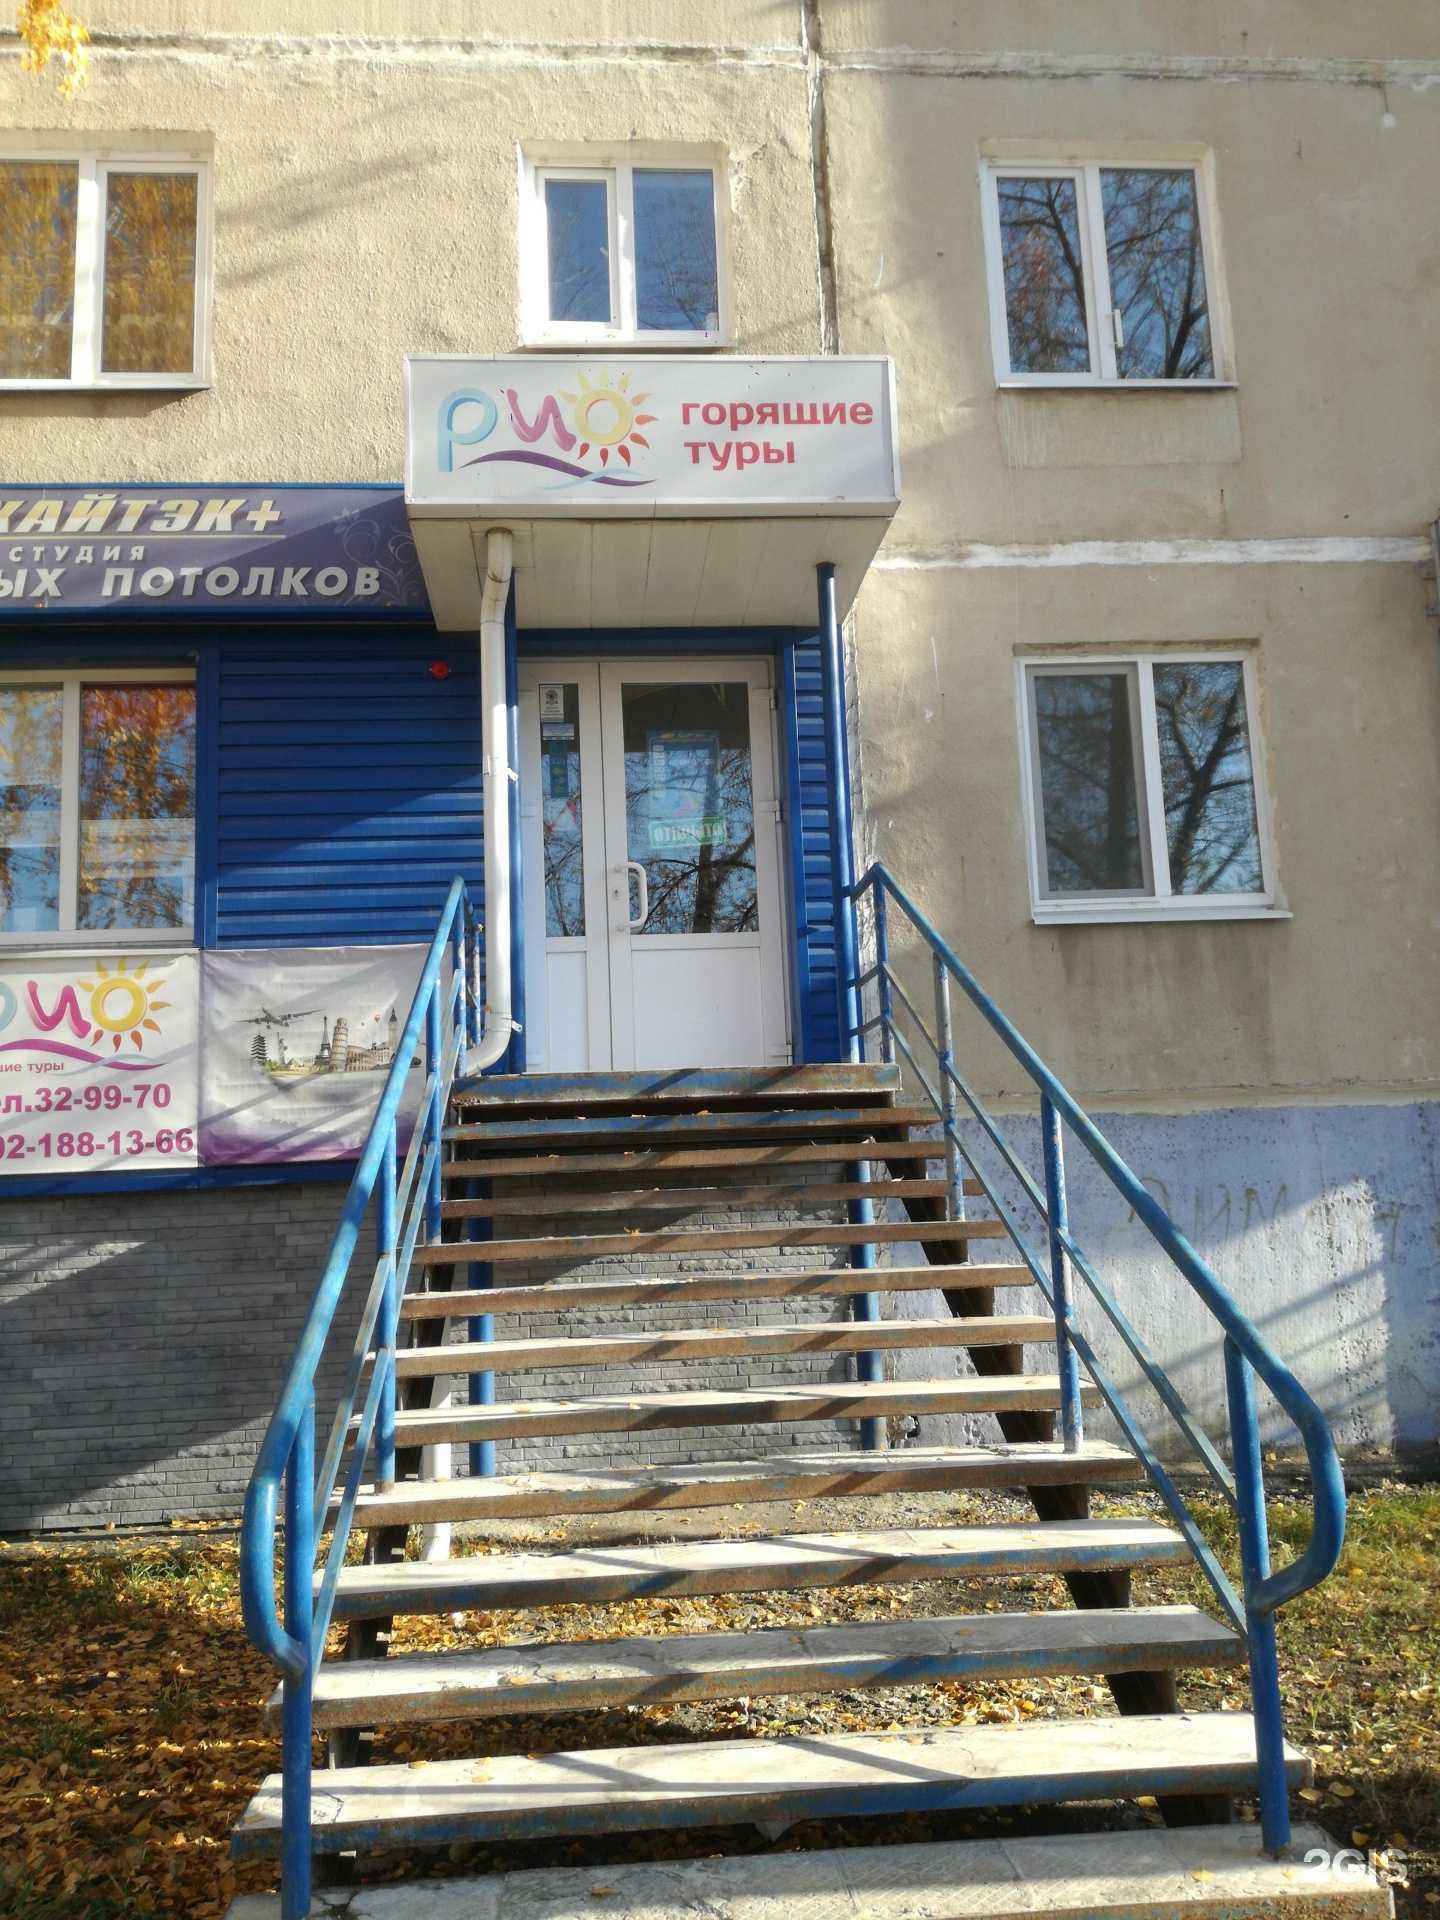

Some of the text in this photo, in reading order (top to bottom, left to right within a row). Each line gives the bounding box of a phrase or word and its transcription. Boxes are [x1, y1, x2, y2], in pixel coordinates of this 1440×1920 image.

[681, 400, 874, 431] горящие
[684, 440, 796, 472] туры
[102, 565, 382, 597] ПОТОЛКОВ
[27, 1062, 65, 1074] туры
[0, 1083, 172, 1114] л.32-99-70
[0, 1127, 194, 1160] 2-188-13-66
